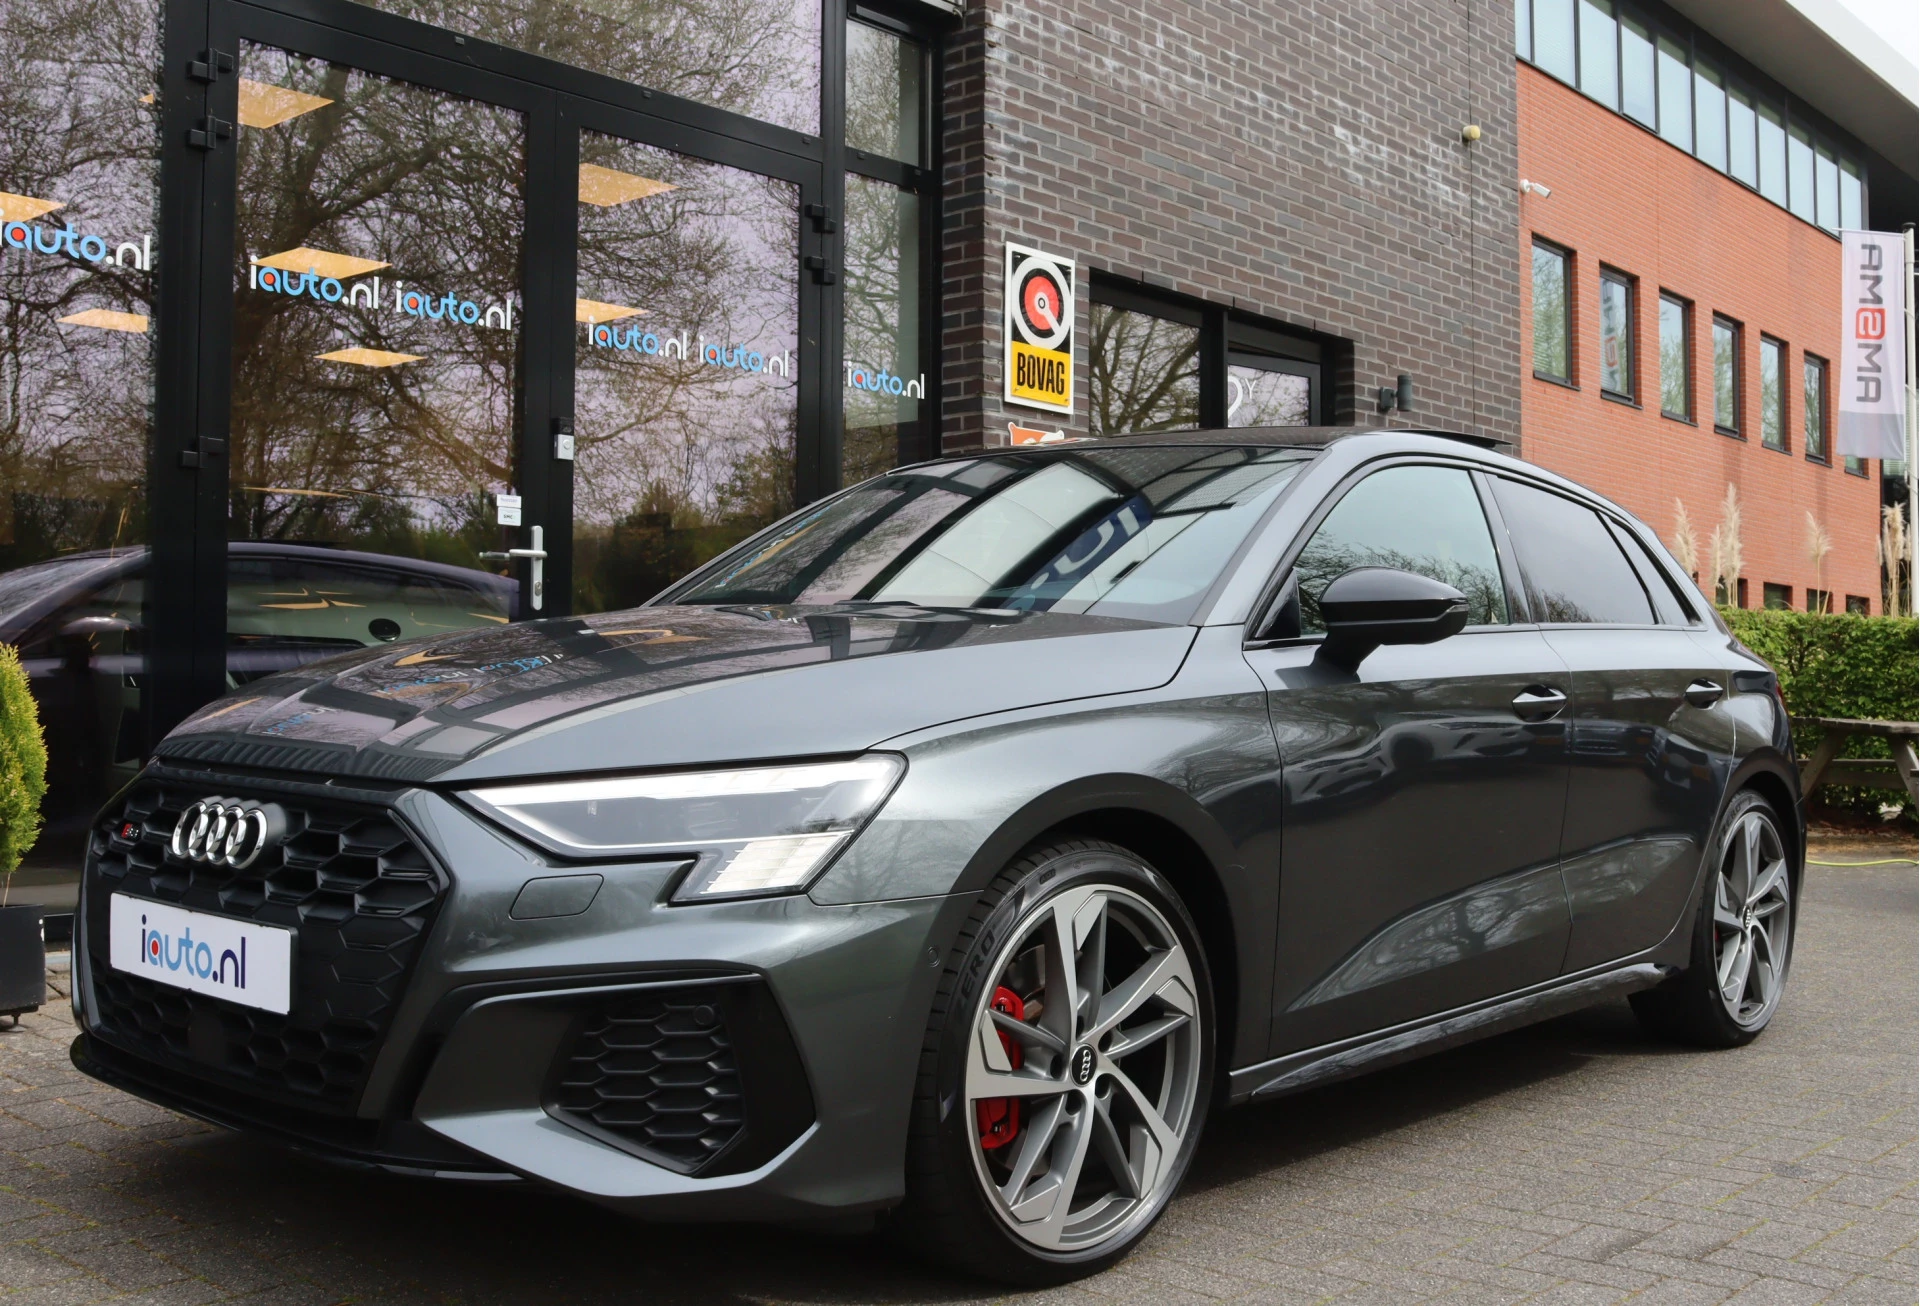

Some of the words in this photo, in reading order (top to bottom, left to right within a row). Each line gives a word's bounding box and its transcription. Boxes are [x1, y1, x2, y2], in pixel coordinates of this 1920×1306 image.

[250, 254, 379, 310] iauto.nl
[395, 280, 512, 331] iauto.nl
[588, 315, 688, 361] iauto.nl
[699, 335, 789, 378] iauto.nl
[1016, 351, 1065, 396] BOVAG
[847, 360, 925, 400] iauto.nl
[141, 914, 246, 989] iauto.nl
